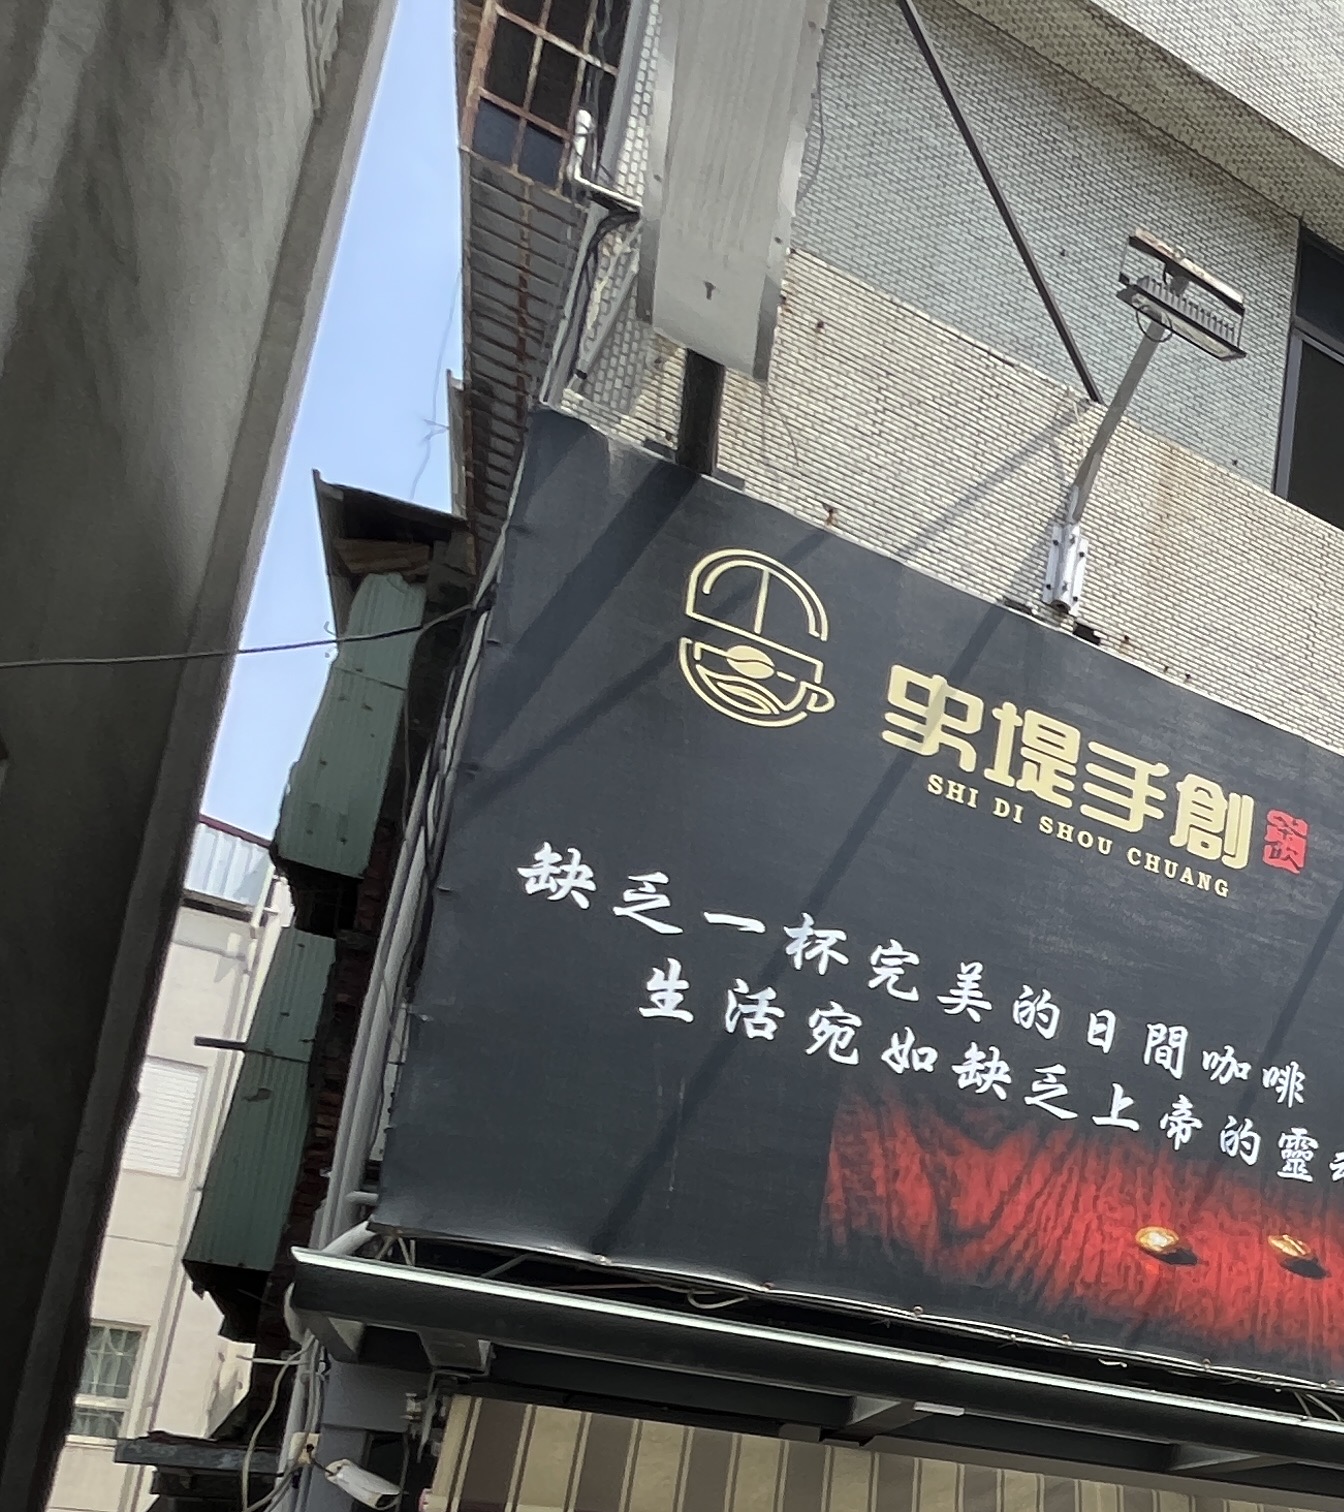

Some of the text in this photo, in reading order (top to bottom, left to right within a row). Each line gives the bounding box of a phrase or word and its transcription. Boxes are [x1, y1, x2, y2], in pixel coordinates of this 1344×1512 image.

[927, 773, 1229, 898] SHI DI SHOU CHUANG
[517, 841, 1306, 1108] 缺乏一杯完美的日間咖啡
